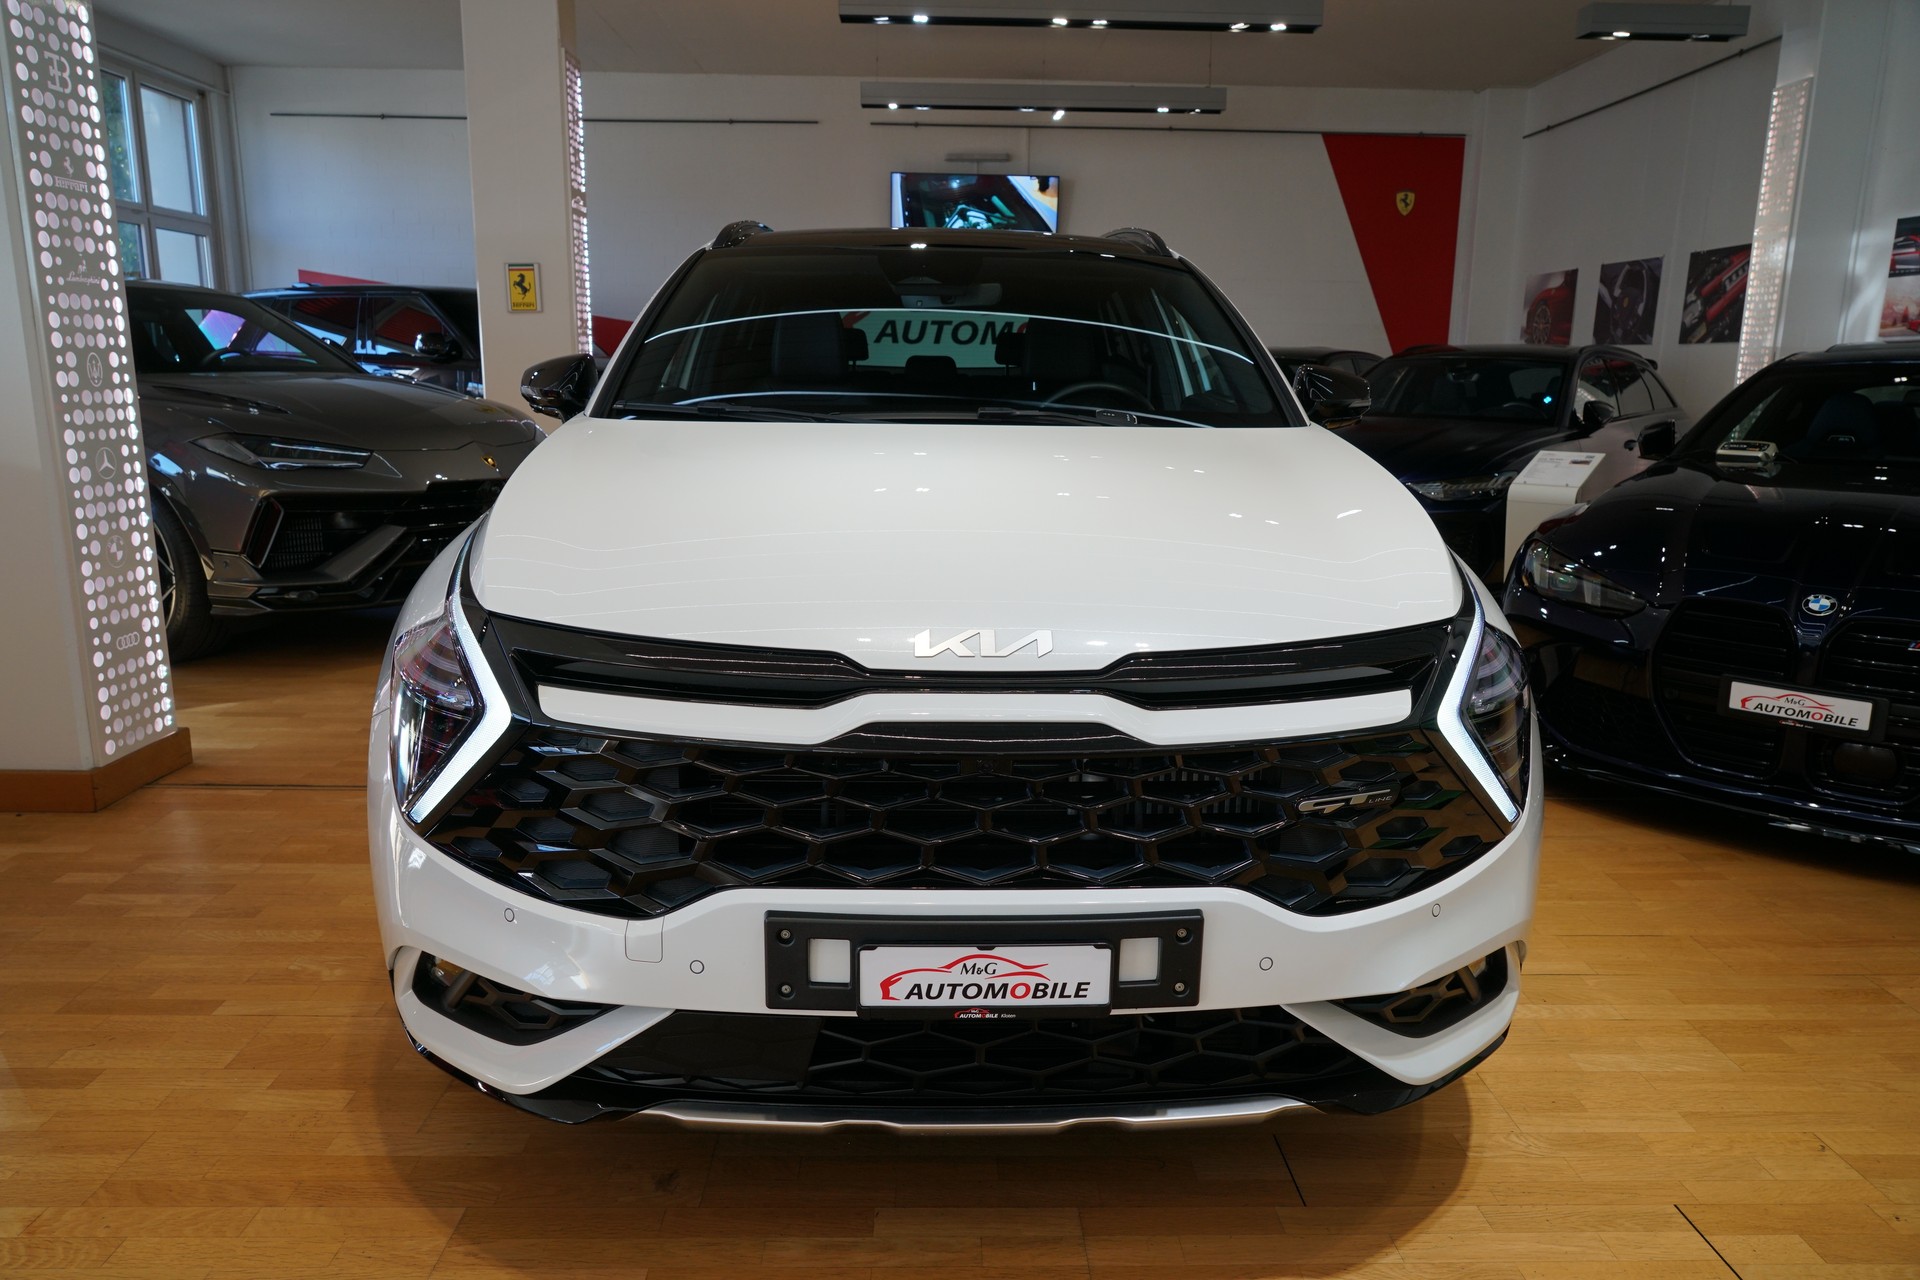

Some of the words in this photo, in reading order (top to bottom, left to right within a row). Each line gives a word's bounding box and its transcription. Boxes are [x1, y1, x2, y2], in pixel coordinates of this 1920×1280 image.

[54, 176, 88, 193] Ferrari
[914, 629, 1053, 658] KIA
[1753, 702, 1859, 727] AUTOMOBILE
[960, 962, 998, 975] M&G
[904, 981, 1091, 1000] AUTOMOBILE
